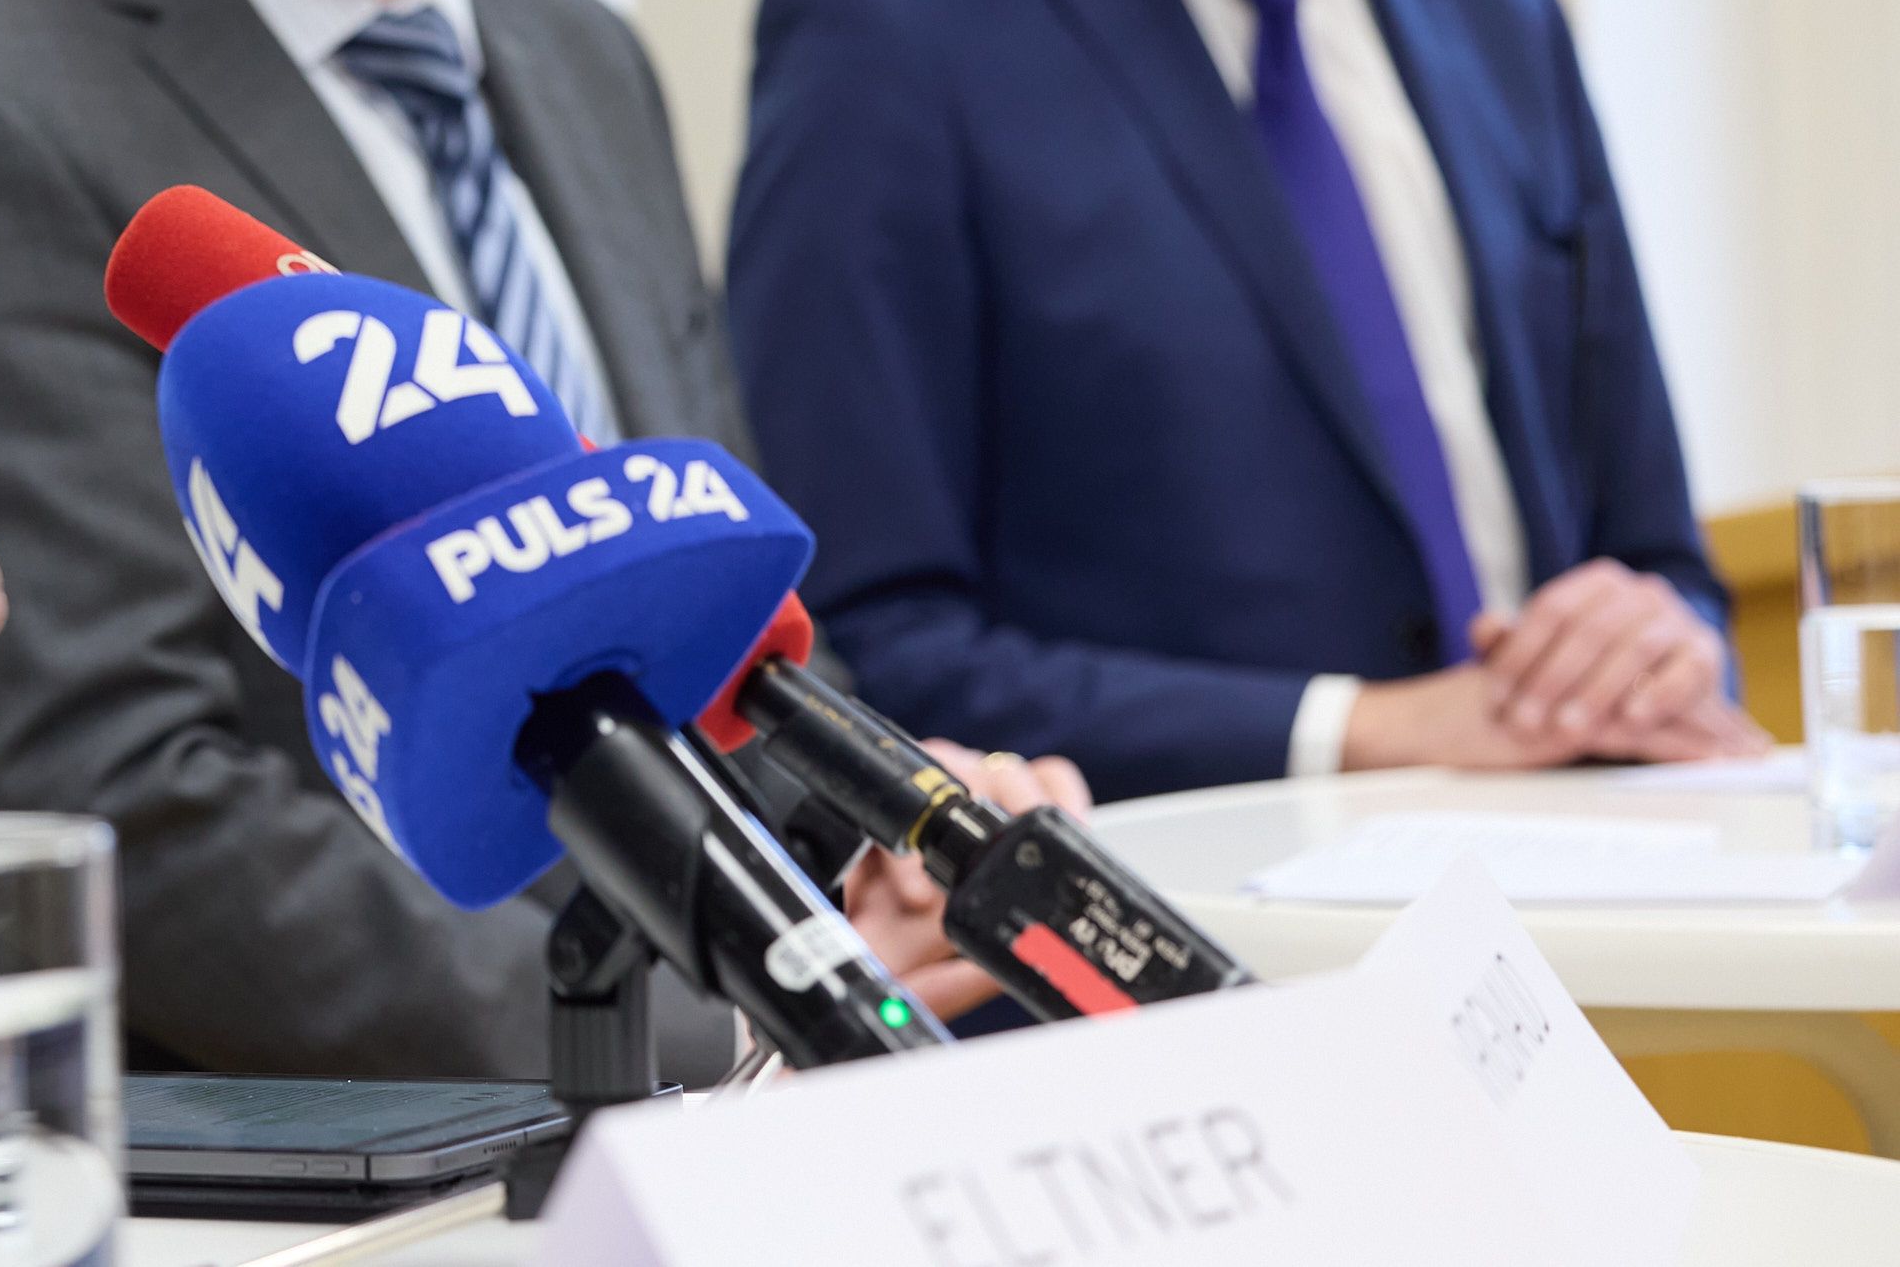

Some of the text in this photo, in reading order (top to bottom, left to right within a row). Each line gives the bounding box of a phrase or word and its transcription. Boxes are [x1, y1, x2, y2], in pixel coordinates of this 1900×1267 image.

[293, 309, 539, 445] 24
[426, 455, 749, 603] PULS 24
[319, 655, 392, 781] 24
[899, 1107, 1297, 1267] ELTNER
